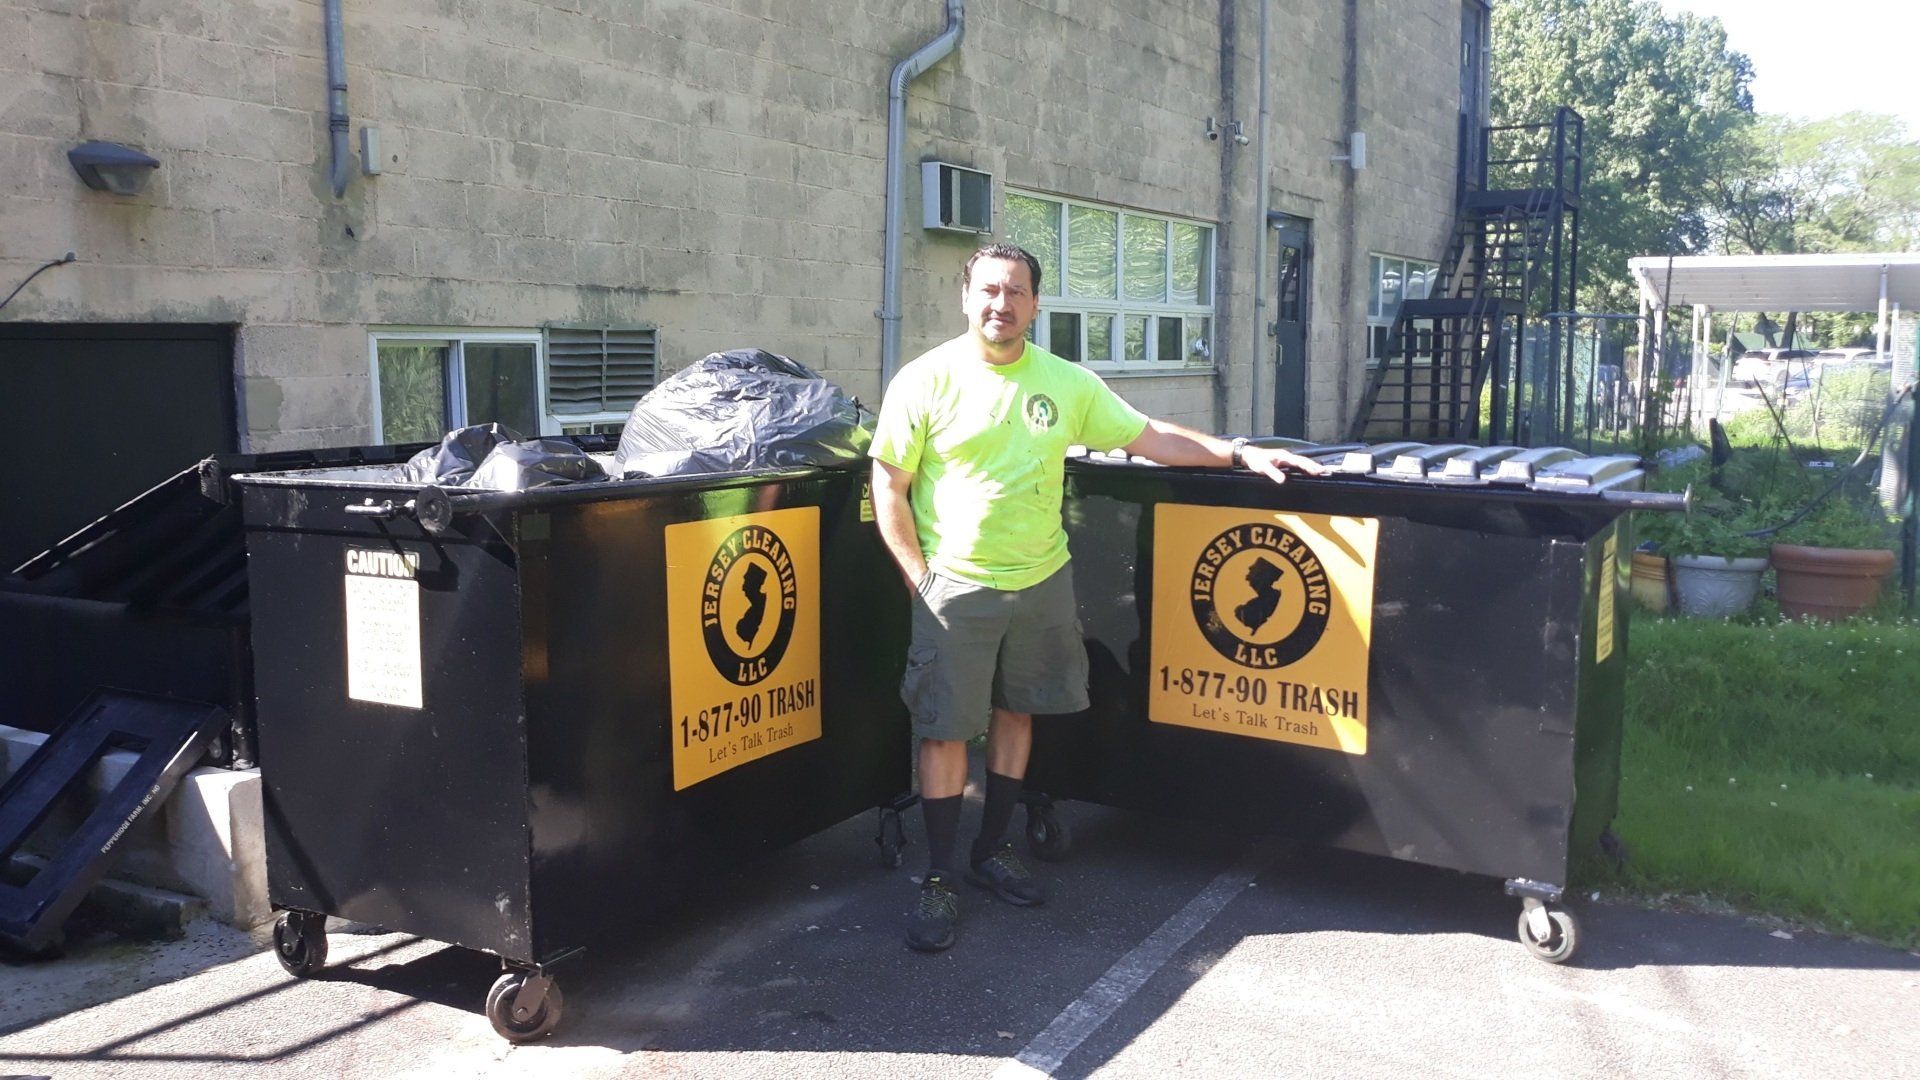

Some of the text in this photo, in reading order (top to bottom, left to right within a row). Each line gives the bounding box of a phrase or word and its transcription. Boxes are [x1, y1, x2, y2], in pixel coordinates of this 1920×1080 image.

[346, 549, 416, 578] CAUTION
[704, 528, 796, 628] JERSEY CLEANING
[1194, 526, 1327, 616] JERSEY CLEANING
[737, 656, 768, 683] LLC
[1234, 643, 1278, 666] LLC
[680, 678, 815, 748] 1-877-90 TRASH
[1159, 665, 1358, 719] 1-877-90 TRASH
[1192, 702, 1319, 737] Let's Talk Trash
[708, 721, 794, 764] Let's Talk Trash
